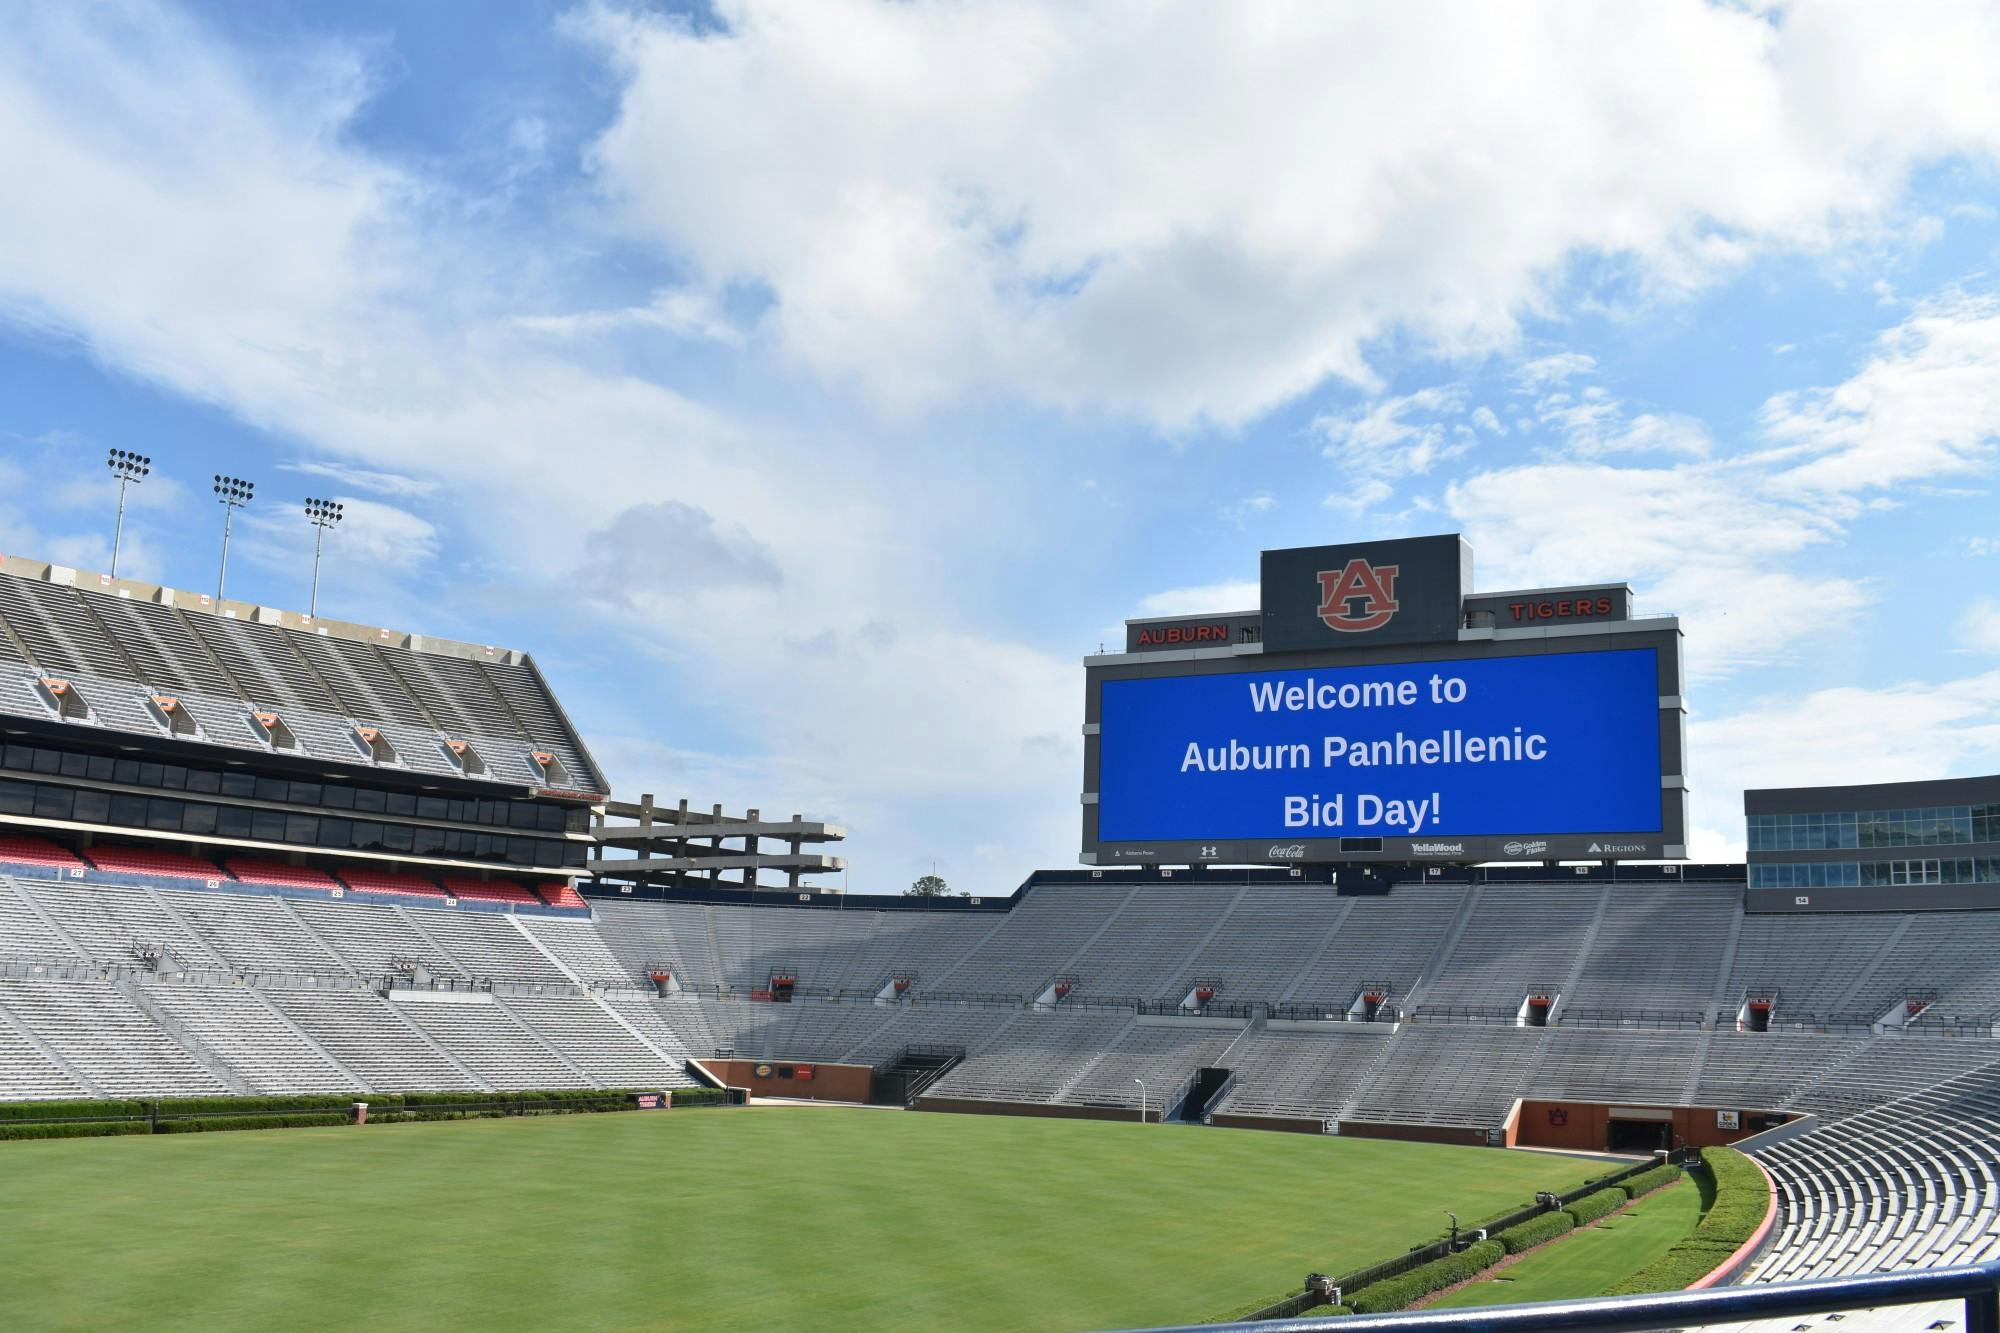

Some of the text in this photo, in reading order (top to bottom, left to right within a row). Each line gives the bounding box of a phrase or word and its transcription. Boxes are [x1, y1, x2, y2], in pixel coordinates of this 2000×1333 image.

[1510, 598, 1611, 620] TIGERS
[1137, 624, 1228, 645] AUBURN
[1249, 674, 1467, 713] Welcome to
[1181, 727, 1547, 772] Auburn Panhellenic
[1284, 792, 1440, 834] Bid Day!
[1412, 843, 1462, 853] YellaWood
[1523, 841, 1547, 849] Golden
[1526, 847, 1546, 856] Flake
